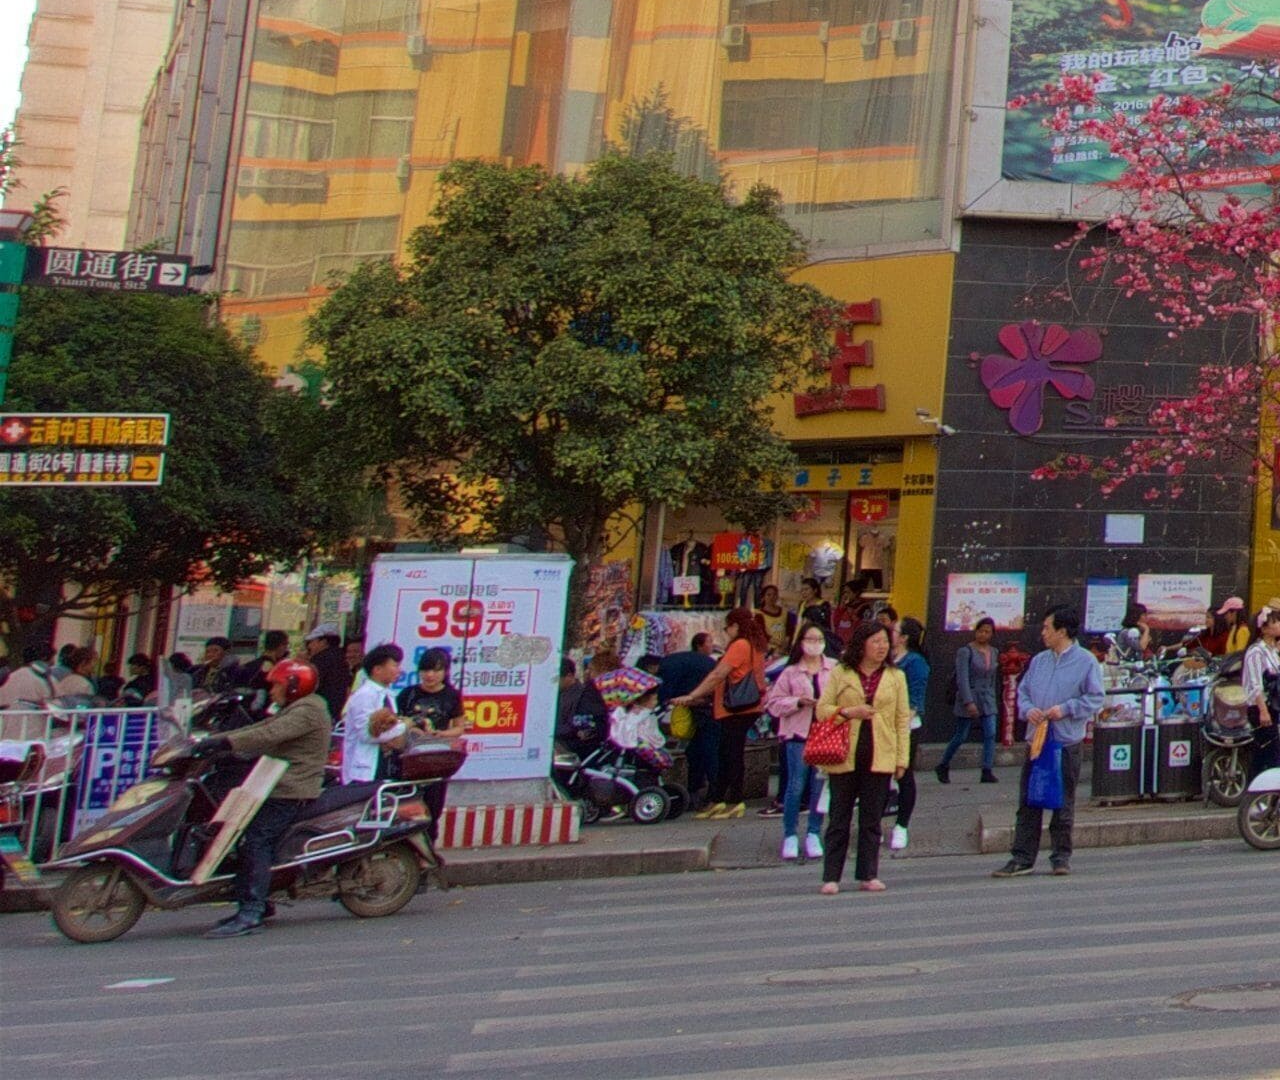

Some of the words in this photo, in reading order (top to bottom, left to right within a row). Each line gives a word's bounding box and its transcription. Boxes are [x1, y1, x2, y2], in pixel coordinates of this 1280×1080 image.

[45, 248, 158, 282] 圆通街
[440, 584, 499, 597] 中国电信
[417, 599, 485, 639] 39
